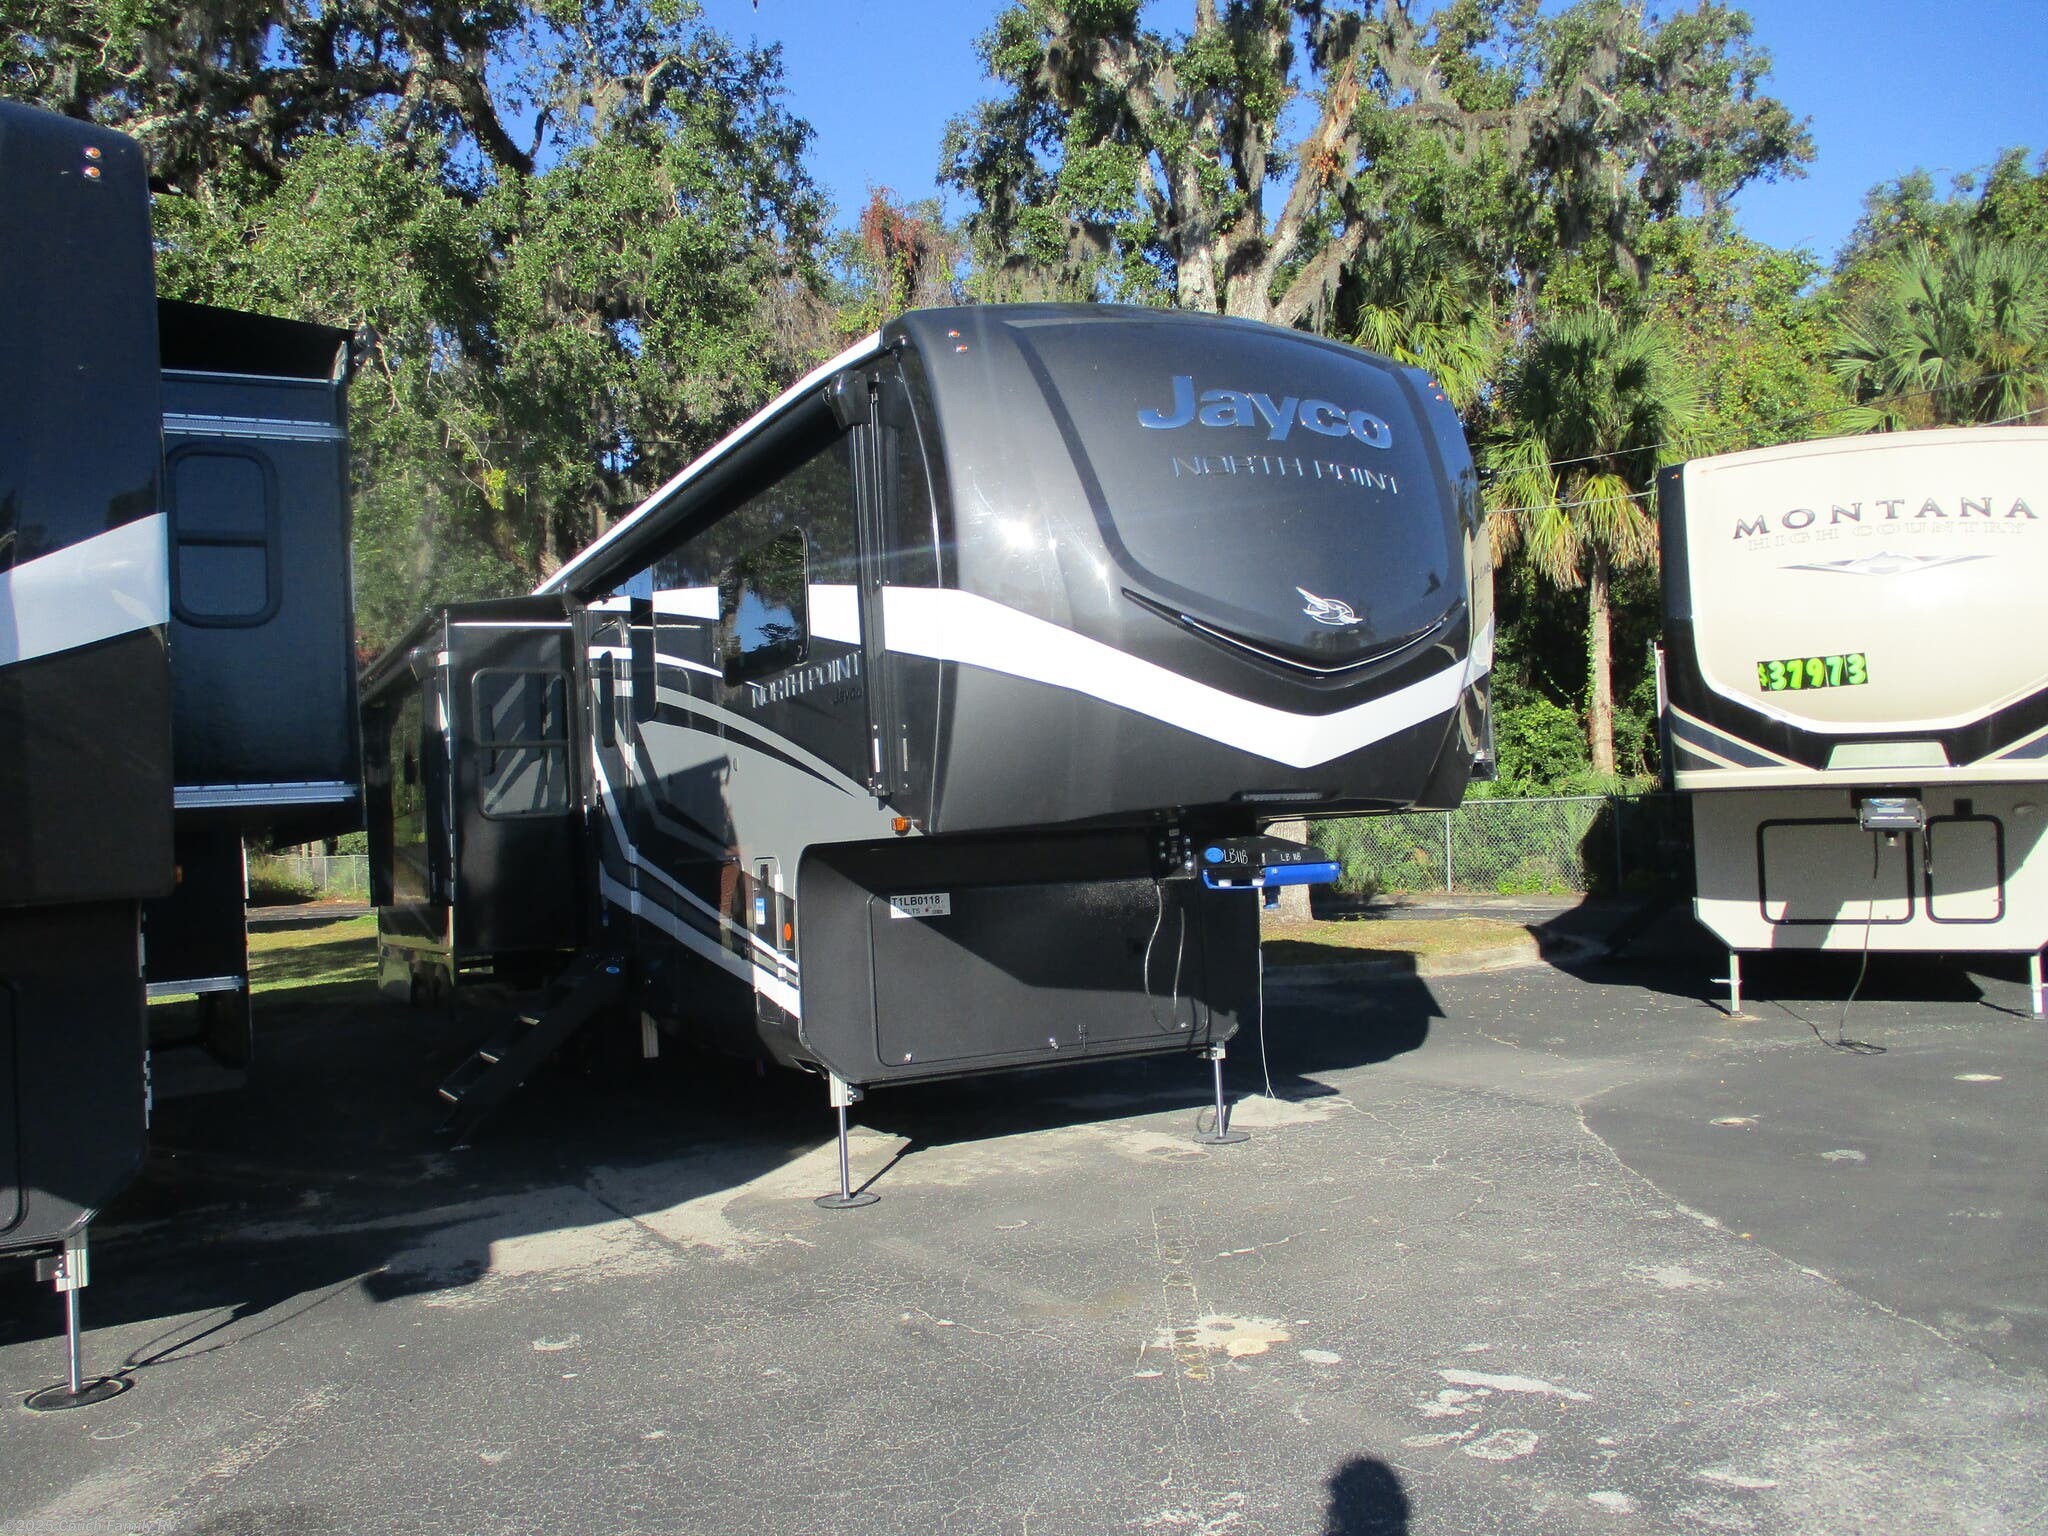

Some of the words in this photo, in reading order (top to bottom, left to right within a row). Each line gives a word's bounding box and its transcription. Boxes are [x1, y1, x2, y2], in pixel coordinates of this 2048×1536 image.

[1137, 375, 1393, 449] Jayco
[1172, 455, 1303, 478] NORTH
[1733, 497, 2039, 540] MONTANA
[1747, 527, 1840, 552] HIGH
[1851, 520, 2026, 538] COUNTRY
[808, 650, 861, 691] POINT
[1758, 653, 1867, 691] $37973
[891, 895, 941, 906] T1LB0118
